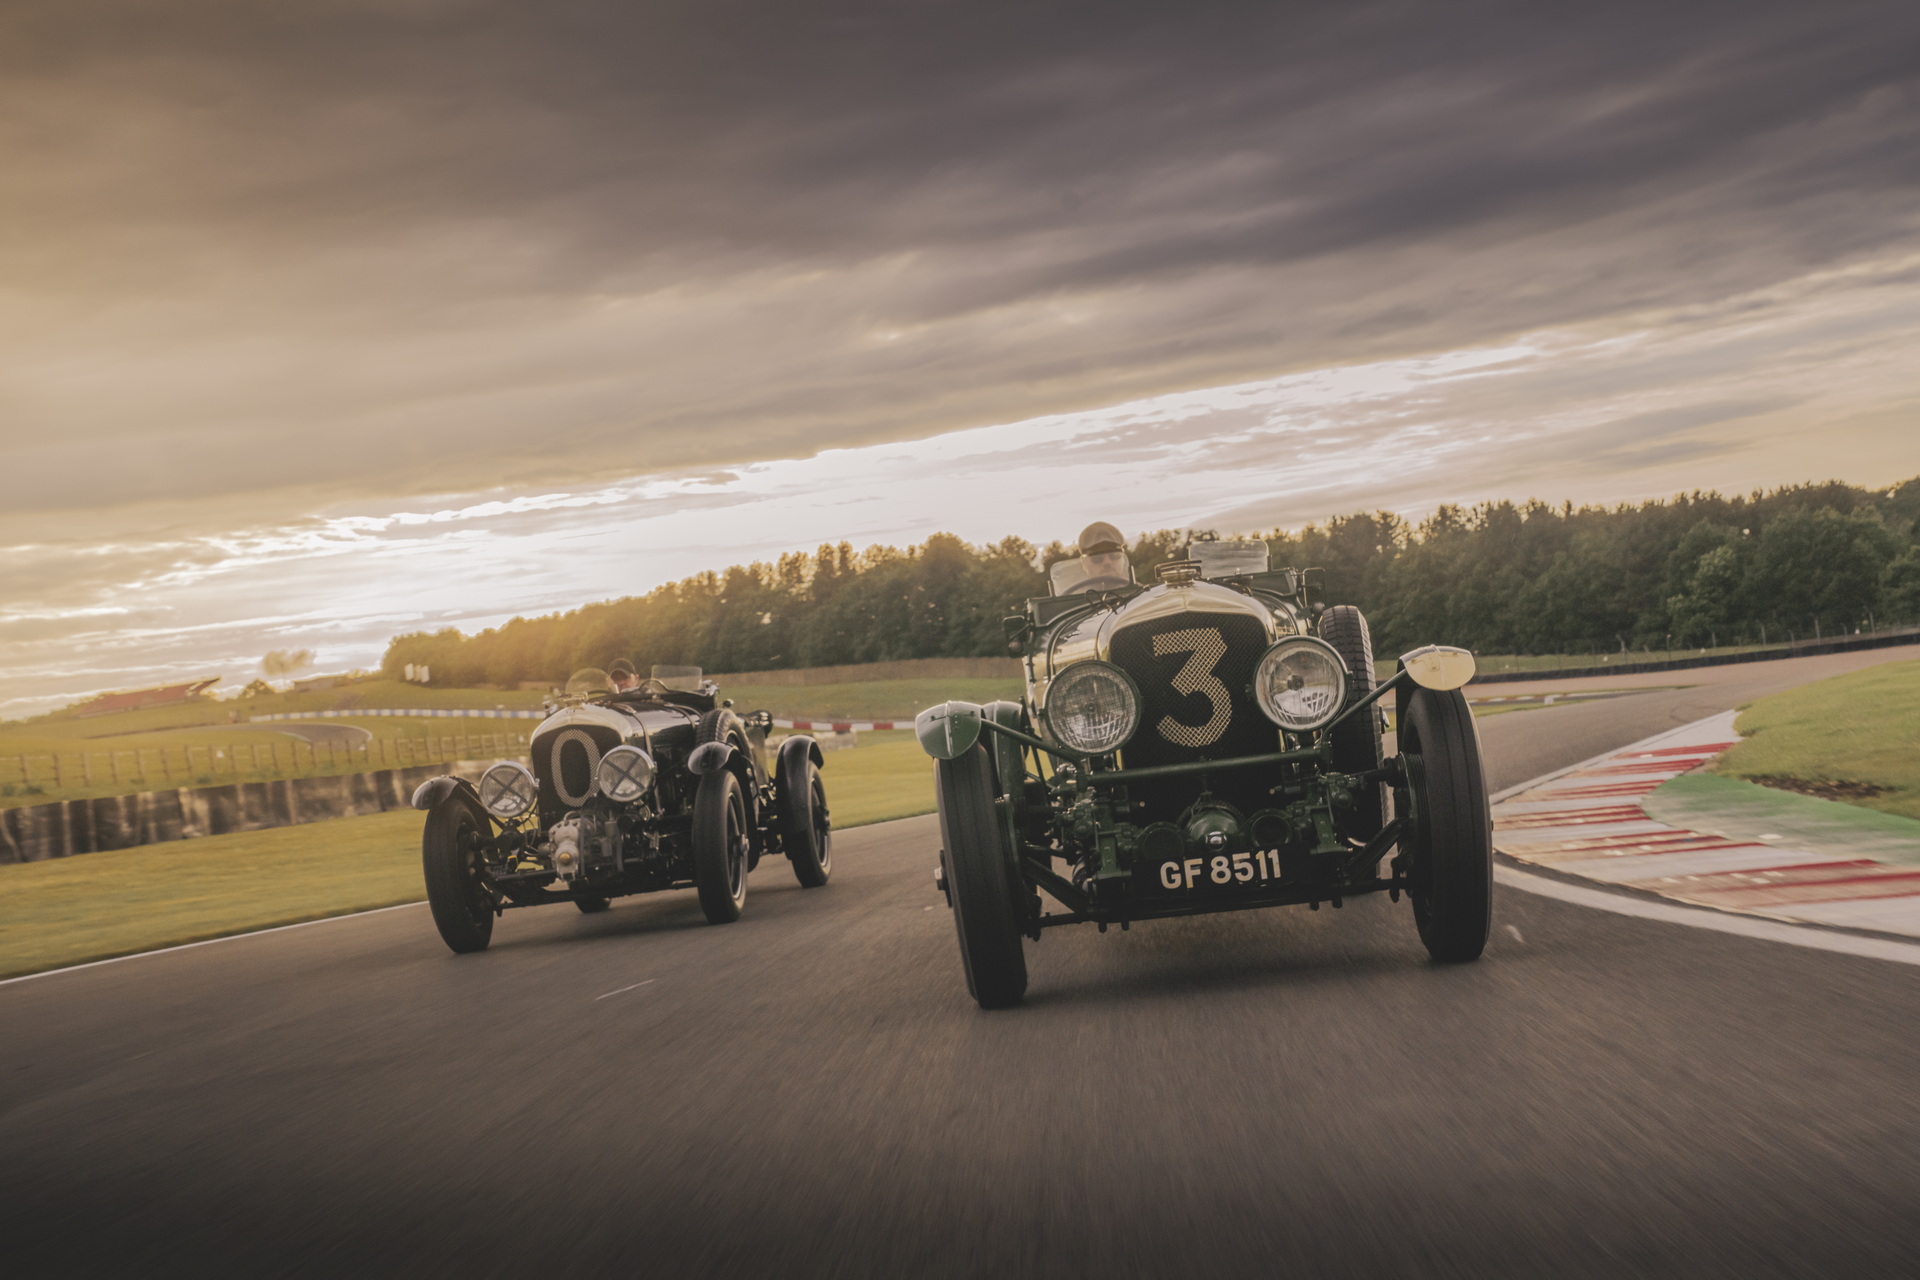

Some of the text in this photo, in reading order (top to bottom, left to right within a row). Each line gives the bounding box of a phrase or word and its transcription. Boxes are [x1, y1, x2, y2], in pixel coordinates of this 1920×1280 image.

[1152, 627, 1232, 747] 3
[1160, 849, 1281, 889] GF 8511
